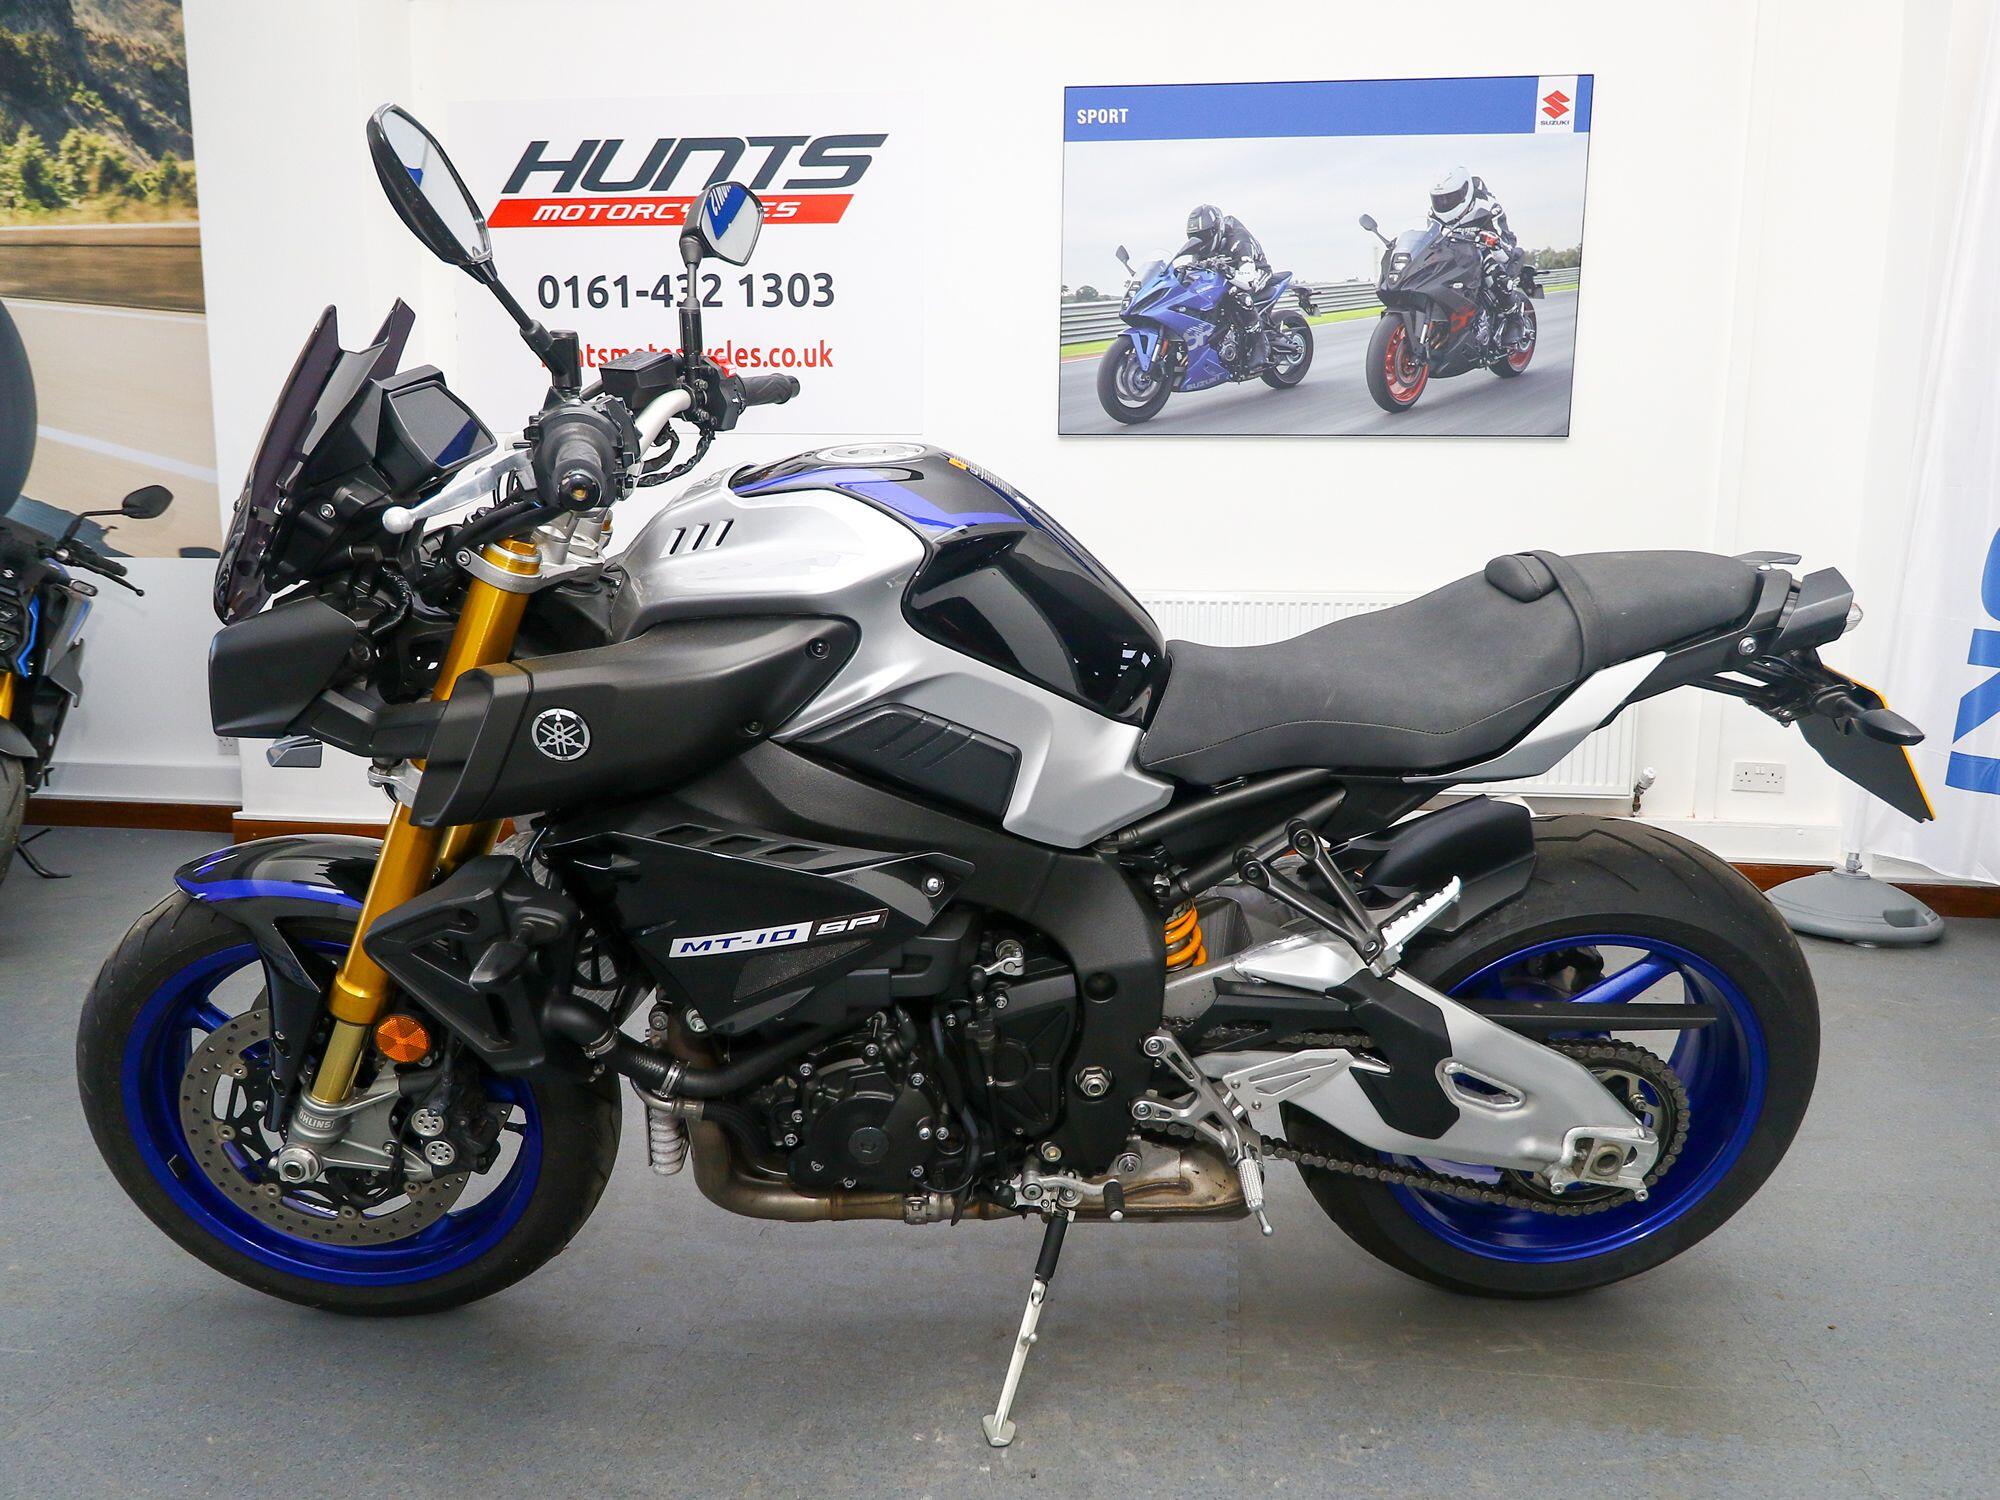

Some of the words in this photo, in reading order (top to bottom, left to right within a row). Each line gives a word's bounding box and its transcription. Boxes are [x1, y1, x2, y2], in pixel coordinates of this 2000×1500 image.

[1077, 107, 1129, 124] SPORT
[532, 201, 801, 222] MOTORCYES
[738, 272, 835, 308] 1303
[680, 928, 798, 953] MT-10
[815, 914, 881, 936] SP
